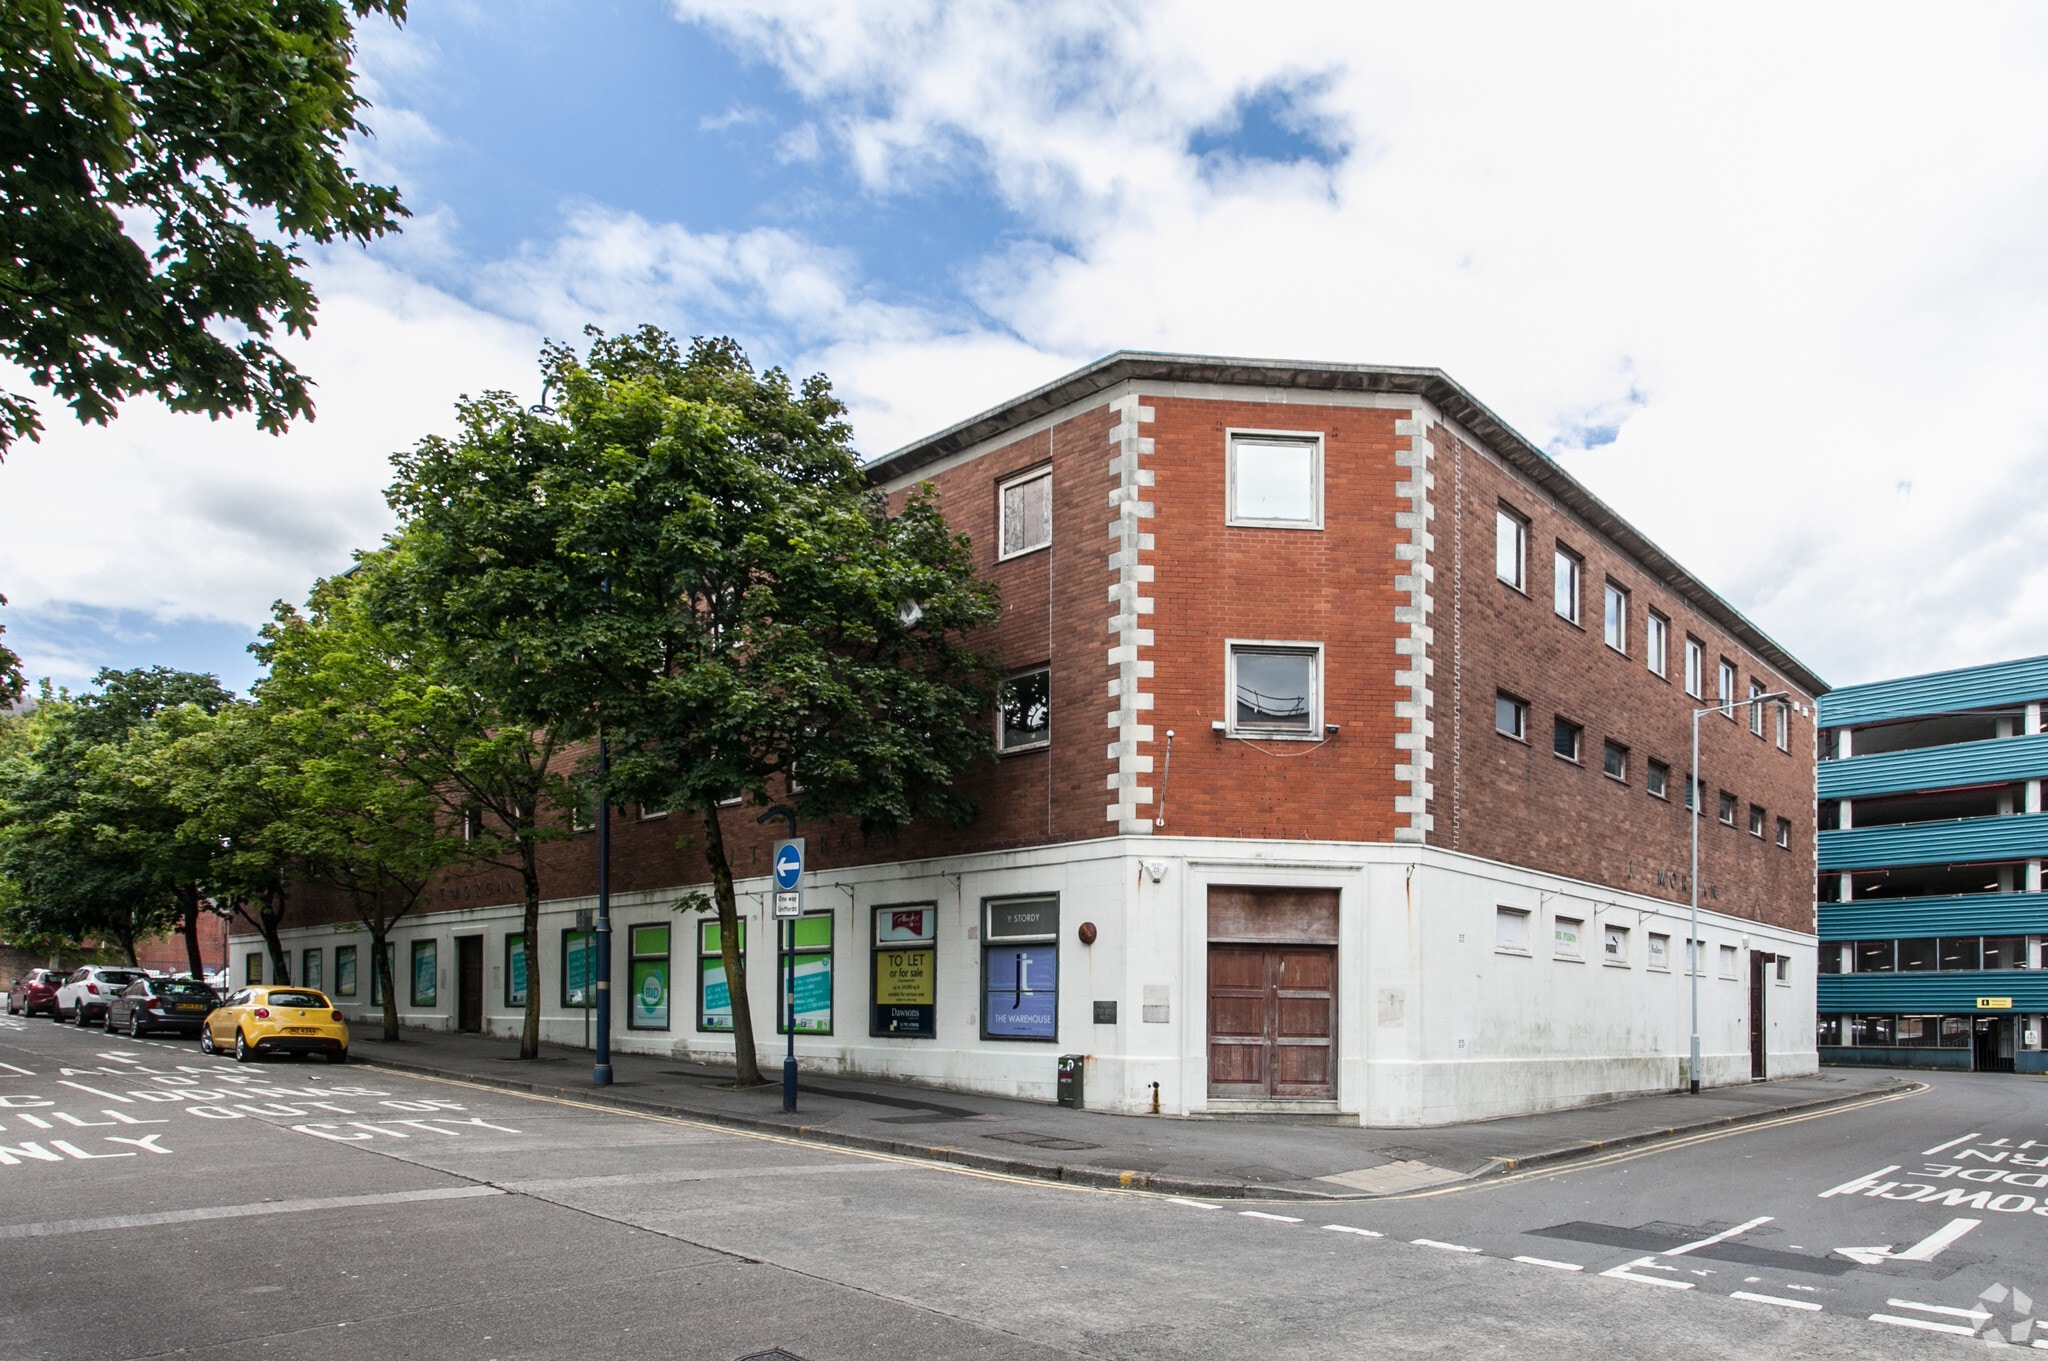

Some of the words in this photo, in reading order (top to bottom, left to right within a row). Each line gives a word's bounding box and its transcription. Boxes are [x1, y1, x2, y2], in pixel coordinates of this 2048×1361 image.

[1657, 870, 1719, 900] MORAN
[1014, 913, 1040, 922] STORDY
[888, 954, 903, 967] TO
[908, 953, 926, 967] LET
[889, 970, 898, 978] or
[899, 967, 909, 978] for
[910, 967, 923, 978] sale
[645, 987, 659, 999] BID
[891, 1007, 920, 1017] Dawsons
[995, 1014, 1007, 1023] THE
[1008, 1014, 1051, 1024] WAREHOUSE
[60, 1065, 269, 1076] ALLAN
[127, 1086, 391, 1102] DDINAS
[185, 1101, 356, 1119] OUT
[379, 1100, 468, 1111] OF
[0, 1109, 170, 1131] ILL
[291, 1118, 523, 1141] CITY
[0, 1134, 173, 1165] NLY
[1953, 1149, 2048, 1167] RN
[1839, 1180, 2048, 1217] OWCH
